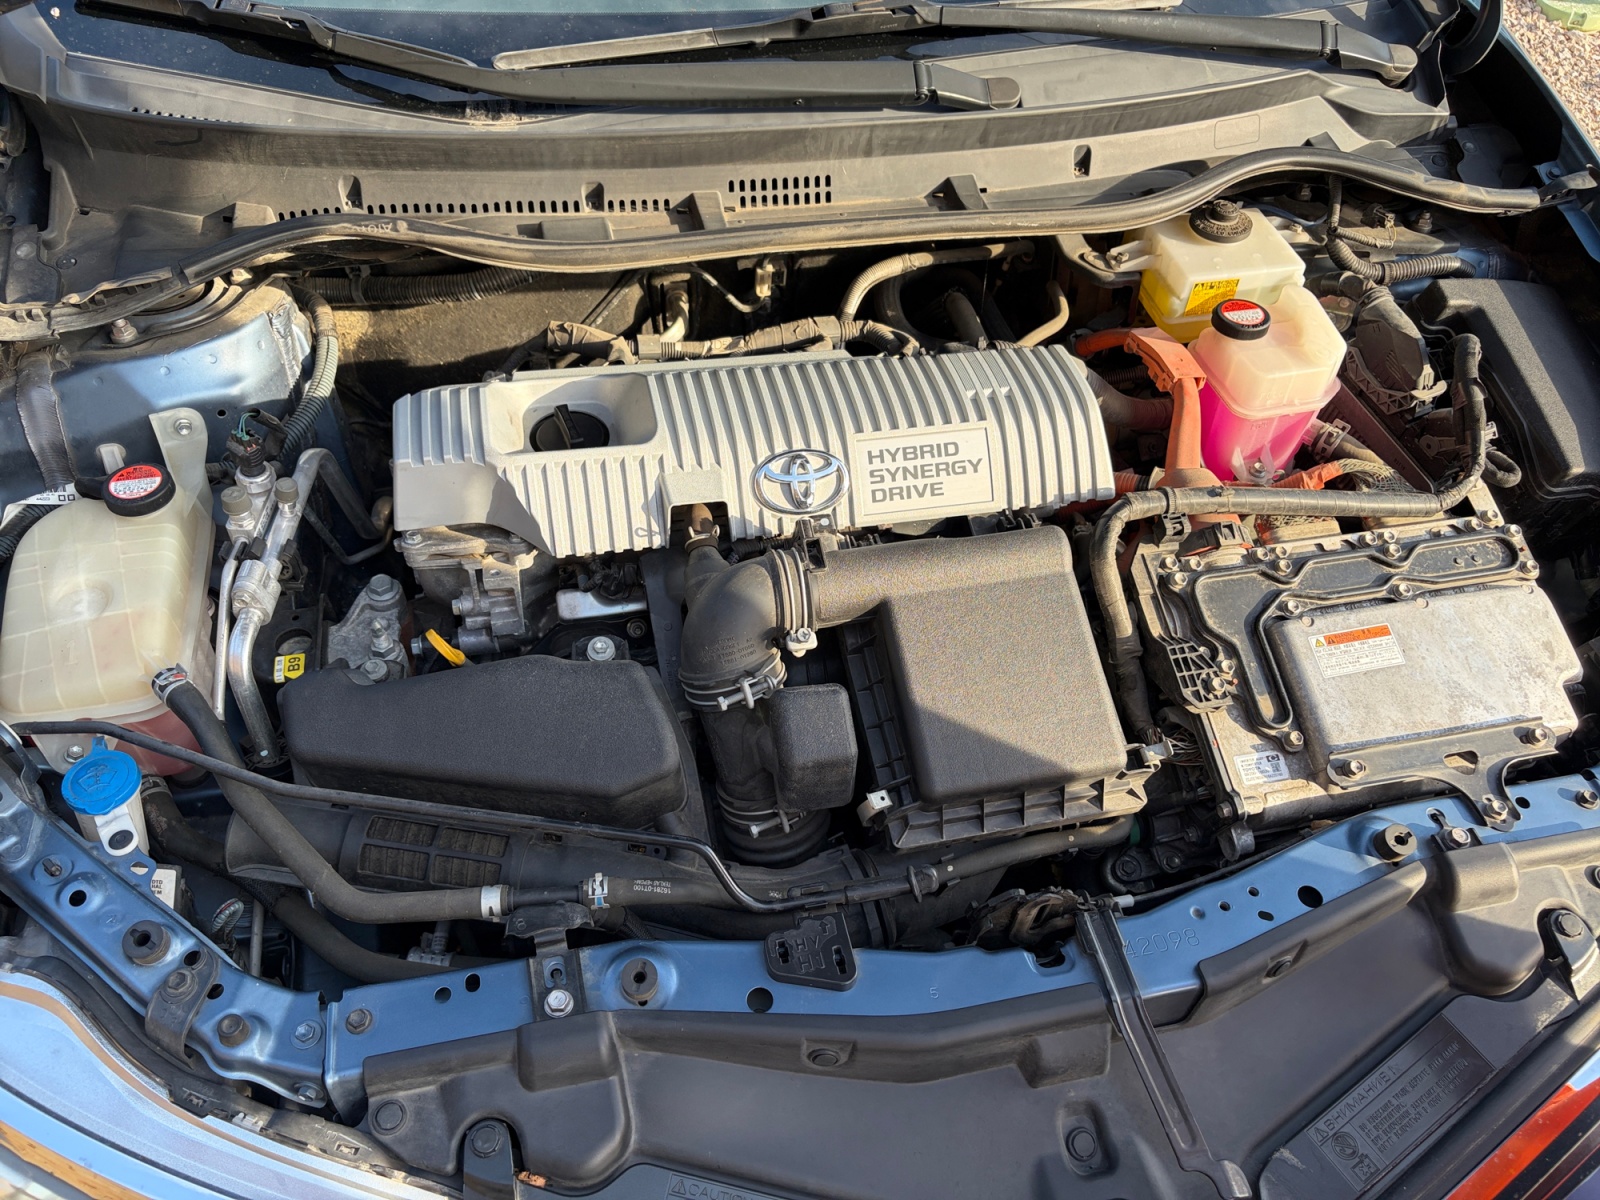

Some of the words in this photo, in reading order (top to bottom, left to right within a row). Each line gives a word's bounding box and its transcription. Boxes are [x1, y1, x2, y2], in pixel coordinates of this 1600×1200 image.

[867, 441, 959, 465] HYBRID
[869, 458, 983, 484] SYNERGY
[871, 482, 944, 503] DRIVE
[288, 656, 301, 672] B9
[1124, 928, 1200, 958] 42098
[929, 986, 939, 999] 5
[689, 1184, 753, 1200] CAUTIO
